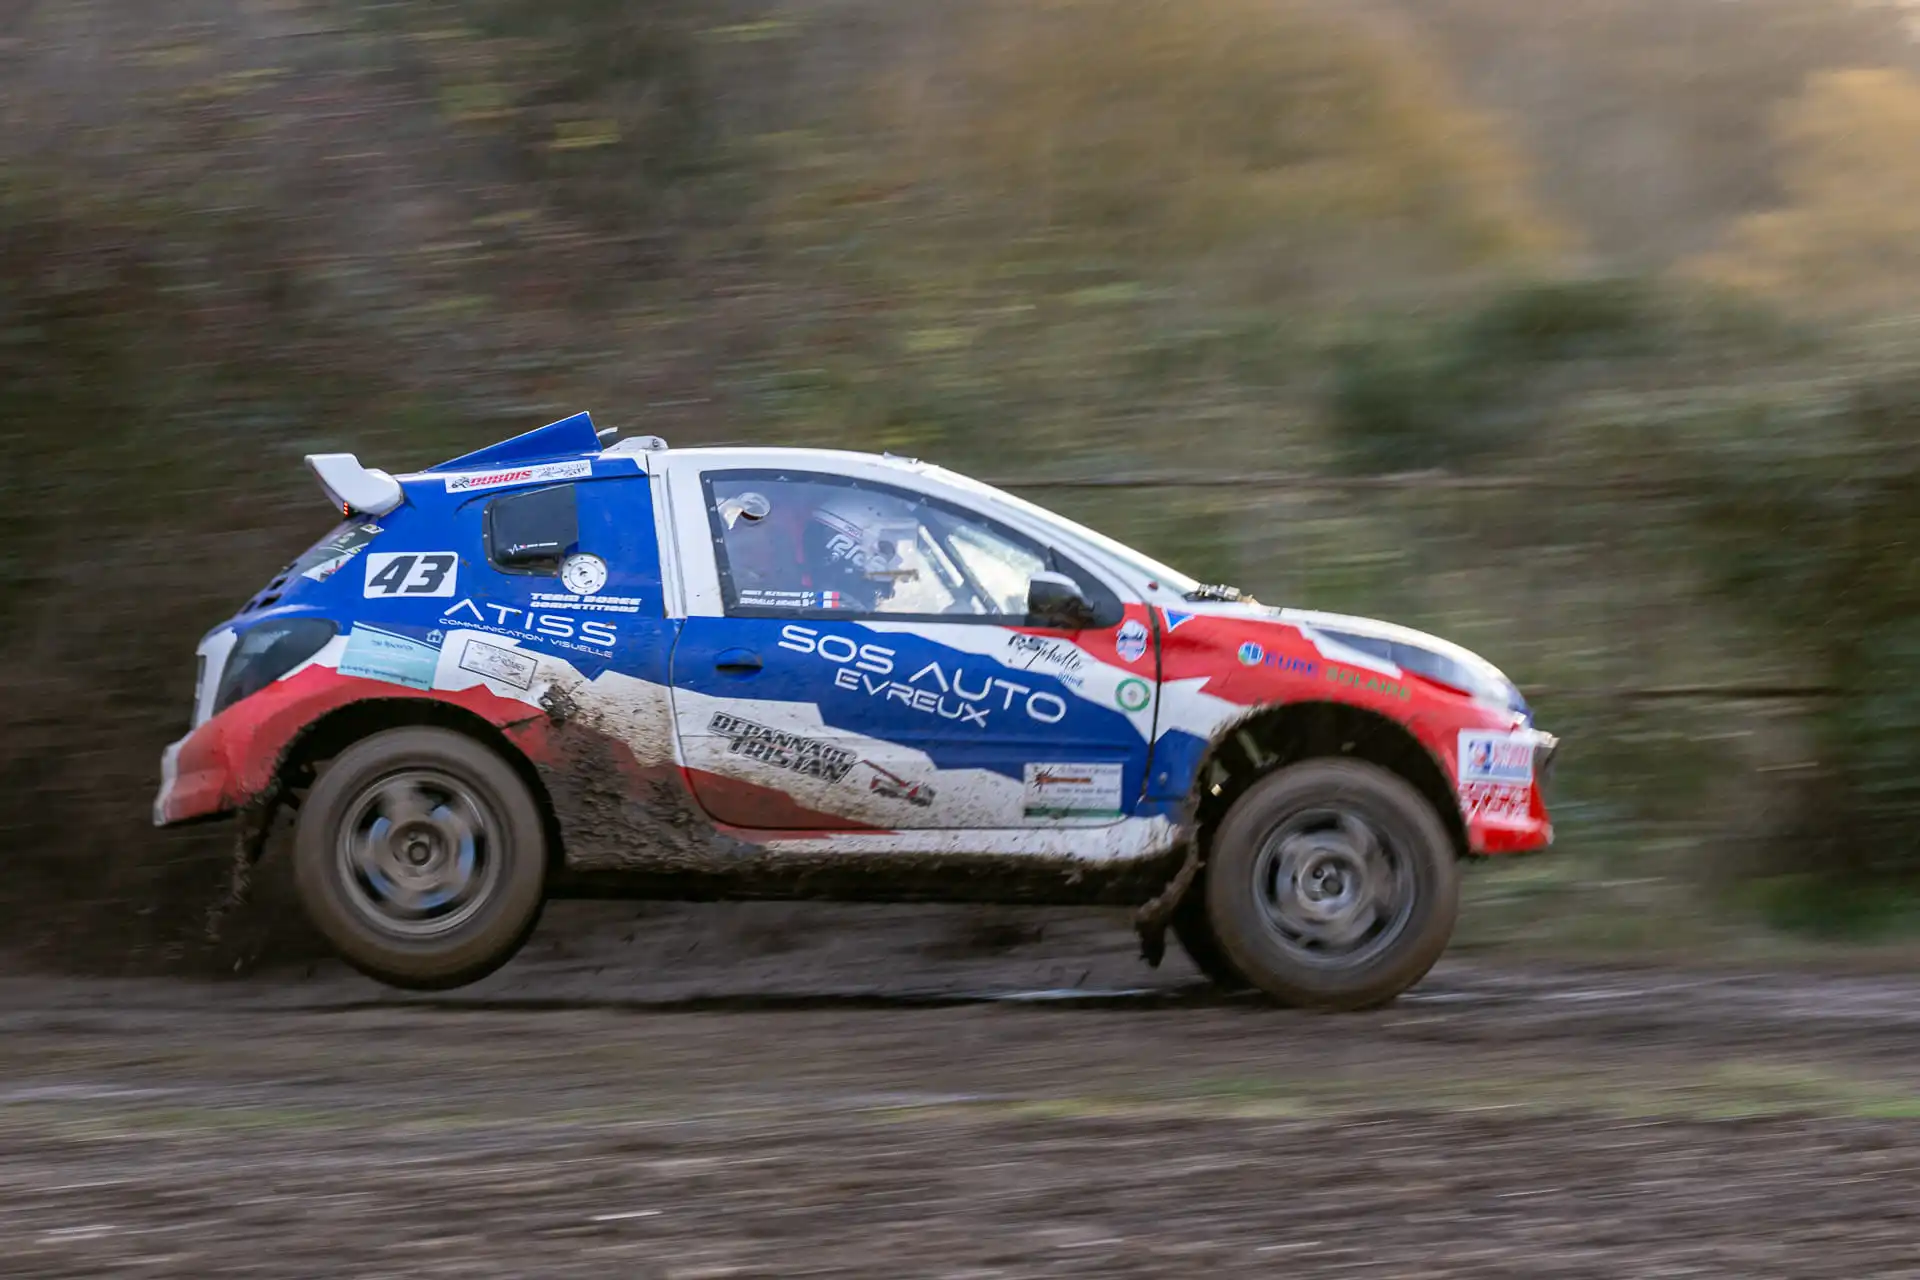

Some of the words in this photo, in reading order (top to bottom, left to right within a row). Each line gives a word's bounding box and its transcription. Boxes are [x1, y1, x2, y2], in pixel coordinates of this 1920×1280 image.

[469, 470, 533, 486] DUBOIS
[367, 555, 456, 594] 43
[438, 618, 545, 643] COMMUNICATION
[549, 638, 614, 659] VISUELLE
[443, 598, 617, 647] ATISS
[778, 624, 896, 675] SOS
[908, 661, 1067, 723] AUTO
[1325, 666, 1412, 701] SOLAIRE
[834, 667, 990, 728] EVREUX
